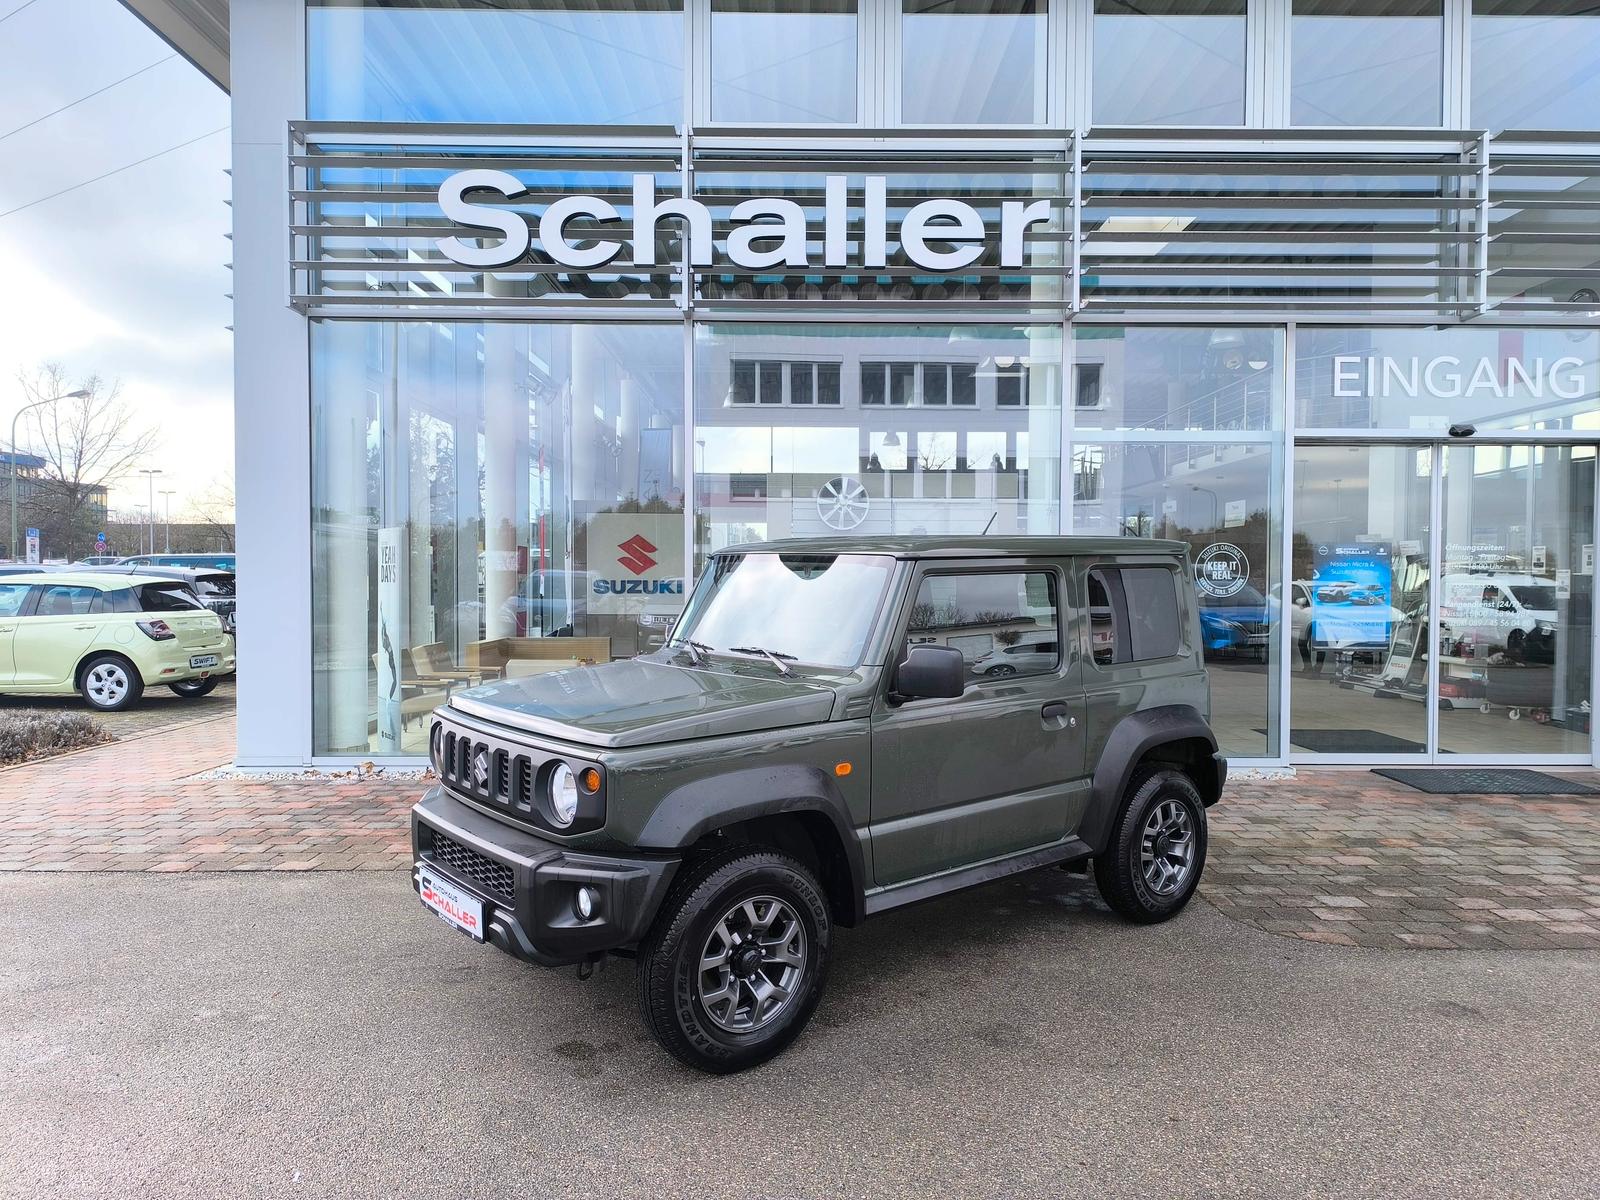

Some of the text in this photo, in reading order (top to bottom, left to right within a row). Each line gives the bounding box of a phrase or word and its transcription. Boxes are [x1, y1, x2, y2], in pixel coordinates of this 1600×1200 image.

[434, 168, 1051, 272] Schaller
[1333, 356, 1586, 398] EINGANG
[381, 545, 396, 564] YEAH
[1201, 544, 1243, 560] SUZUKI ORIGINAL
[381, 564, 396, 583] DAYS
[1207, 561, 1237, 571] KEEP IT
[1212, 571, 1233, 580] REAL
[593, 579, 683, 595] SUZUKI
[193, 656, 214, 665] SWIFT
[422, 876, 477, 930] SCHALLER
[783, 873, 829, 932] DUNLOP
